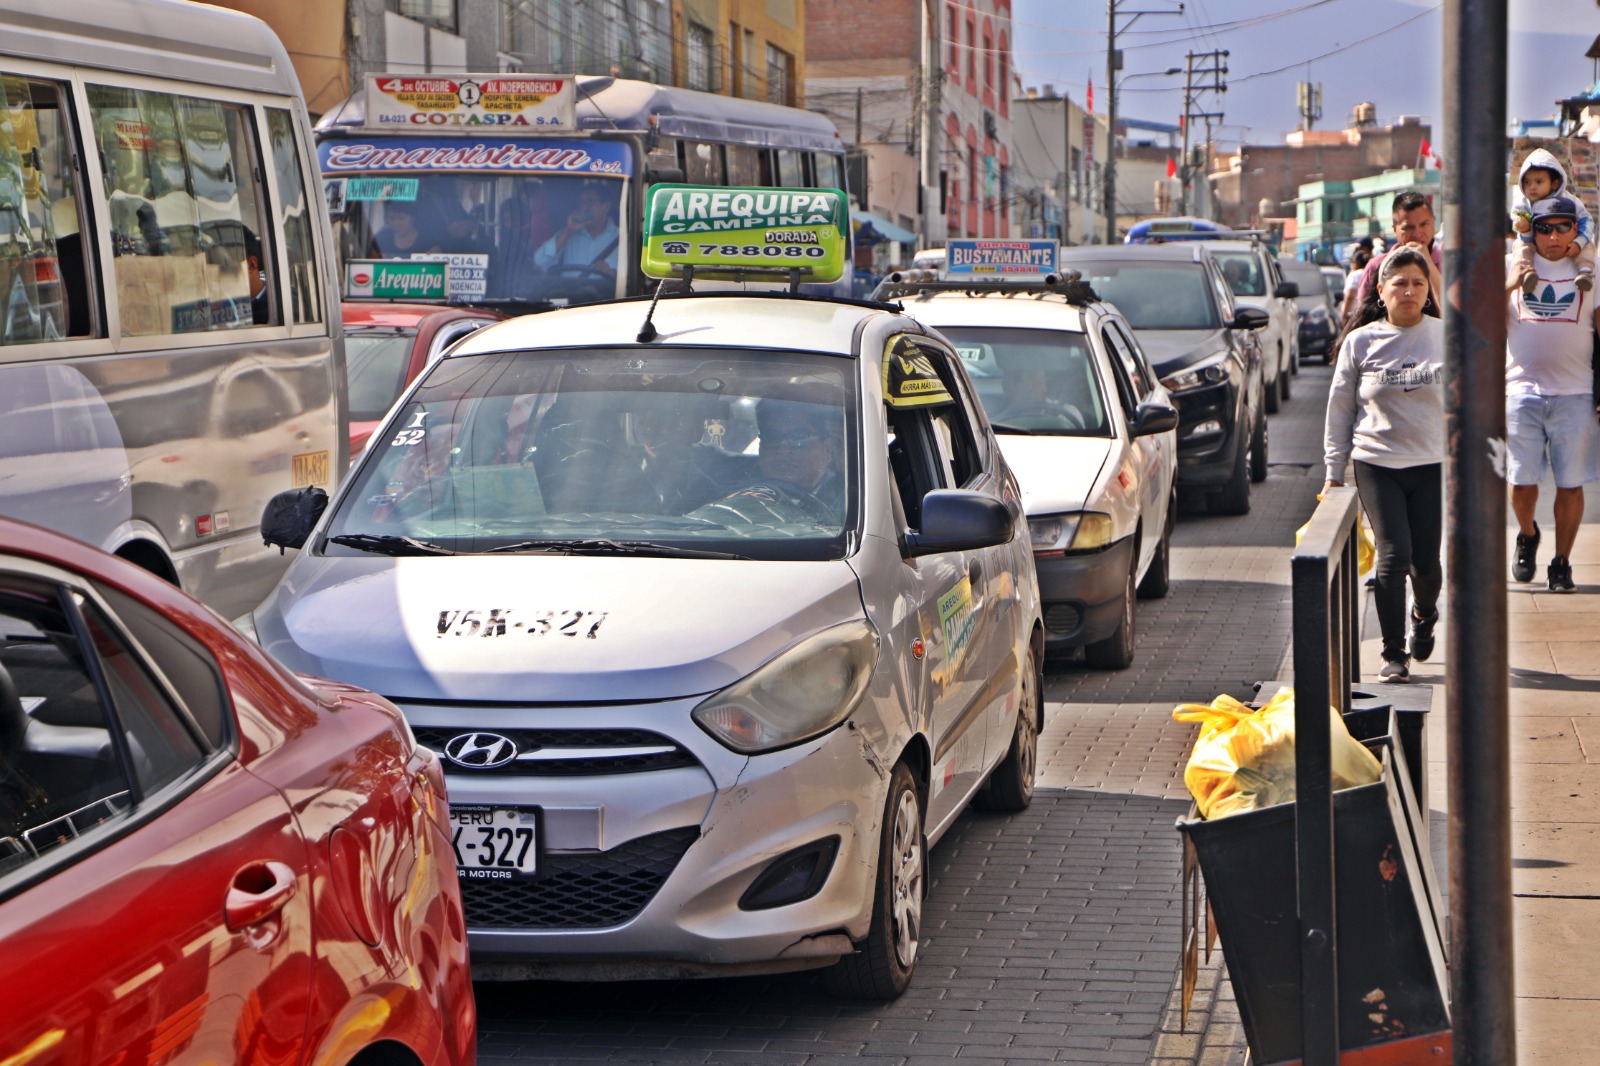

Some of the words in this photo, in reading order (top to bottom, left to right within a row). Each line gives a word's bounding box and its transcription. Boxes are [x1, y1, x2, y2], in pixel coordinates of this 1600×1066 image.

[383, 79, 404, 92] 4
[404, 83, 414, 91] DE
[415, 80, 450, 92] OCTUBRE
[486, 81, 498, 92] AV.
[501, 80, 557, 93] INDEPENDENCIA
[465, 88, 473, 99] 1
[514, 94, 541, 102] GENERAL
[379, 114, 407, 123] EA-023
[410, 112, 530, 126] COTASPA
[536, 117, 564, 125] S.A.
[327, 143, 592, 170] Emarsistran
[662, 192, 832, 222] AREQUIPA
[663, 214, 830, 234] CAMPIÑA
[764, 230, 818, 244] DORADA
[697, 243, 826, 260] 788080
[952, 247, 1053, 267] BUSTAMANTE
[375, 267, 442, 295] Arequipa
[472, 269, 485, 279] XX
[391, 429, 425, 446] 52
[437, 609, 609, 639] V5K-327
